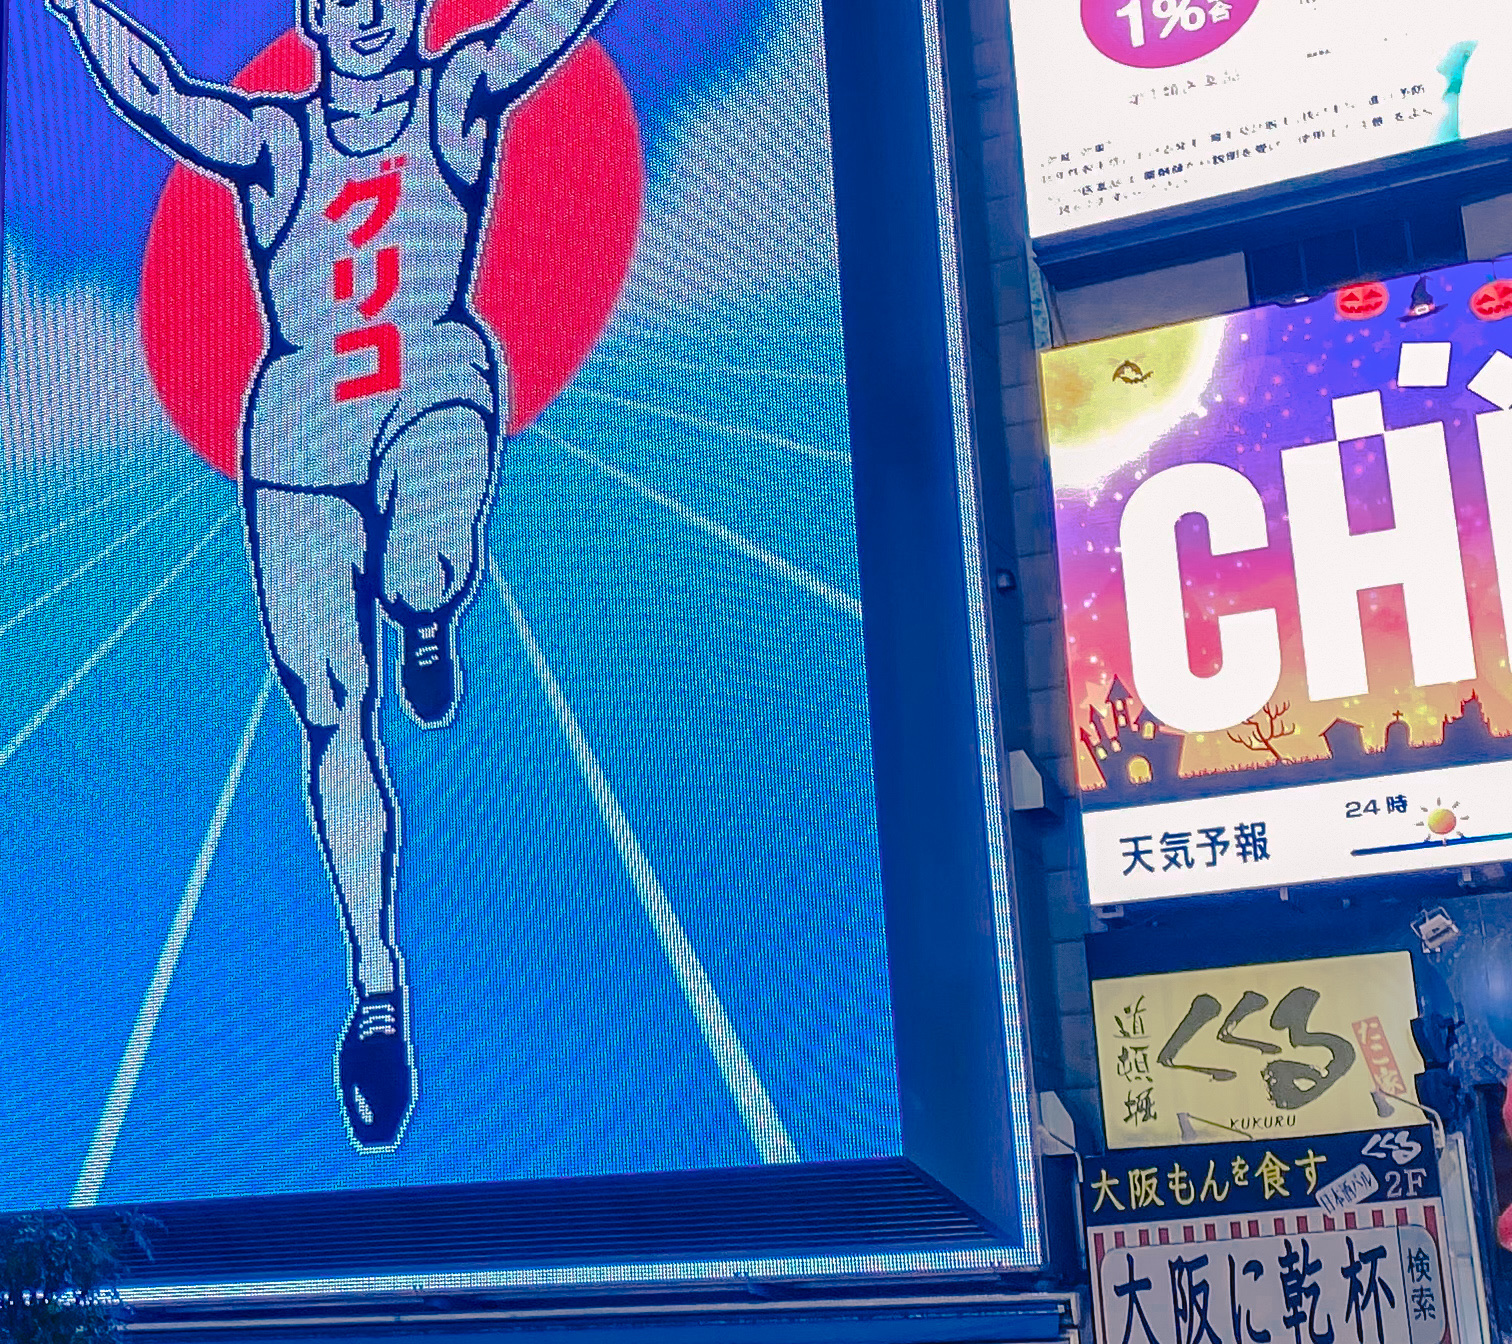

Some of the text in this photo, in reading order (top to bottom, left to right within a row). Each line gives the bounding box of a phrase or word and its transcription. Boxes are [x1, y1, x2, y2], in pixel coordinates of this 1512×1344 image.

[324, 153, 407, 404] グリコ
[1119, 821, 1272, 876] 天気予報
[1113, 994, 1158, 1128] 道頓堀
[1156, 986, 1356, 1110] くくる
[1229, 1113, 1297, 1130] KUKURU
[1361, 1130, 1423, 1165] くくる
[1090, 1149, 1328, 1214] 大阪もんを食す
[1319, 1172, 1374, 1215] 日本酒バル
[1384, 1168, 1428, 1199] 2F
[1406, 1246, 1438, 1321] 検索
